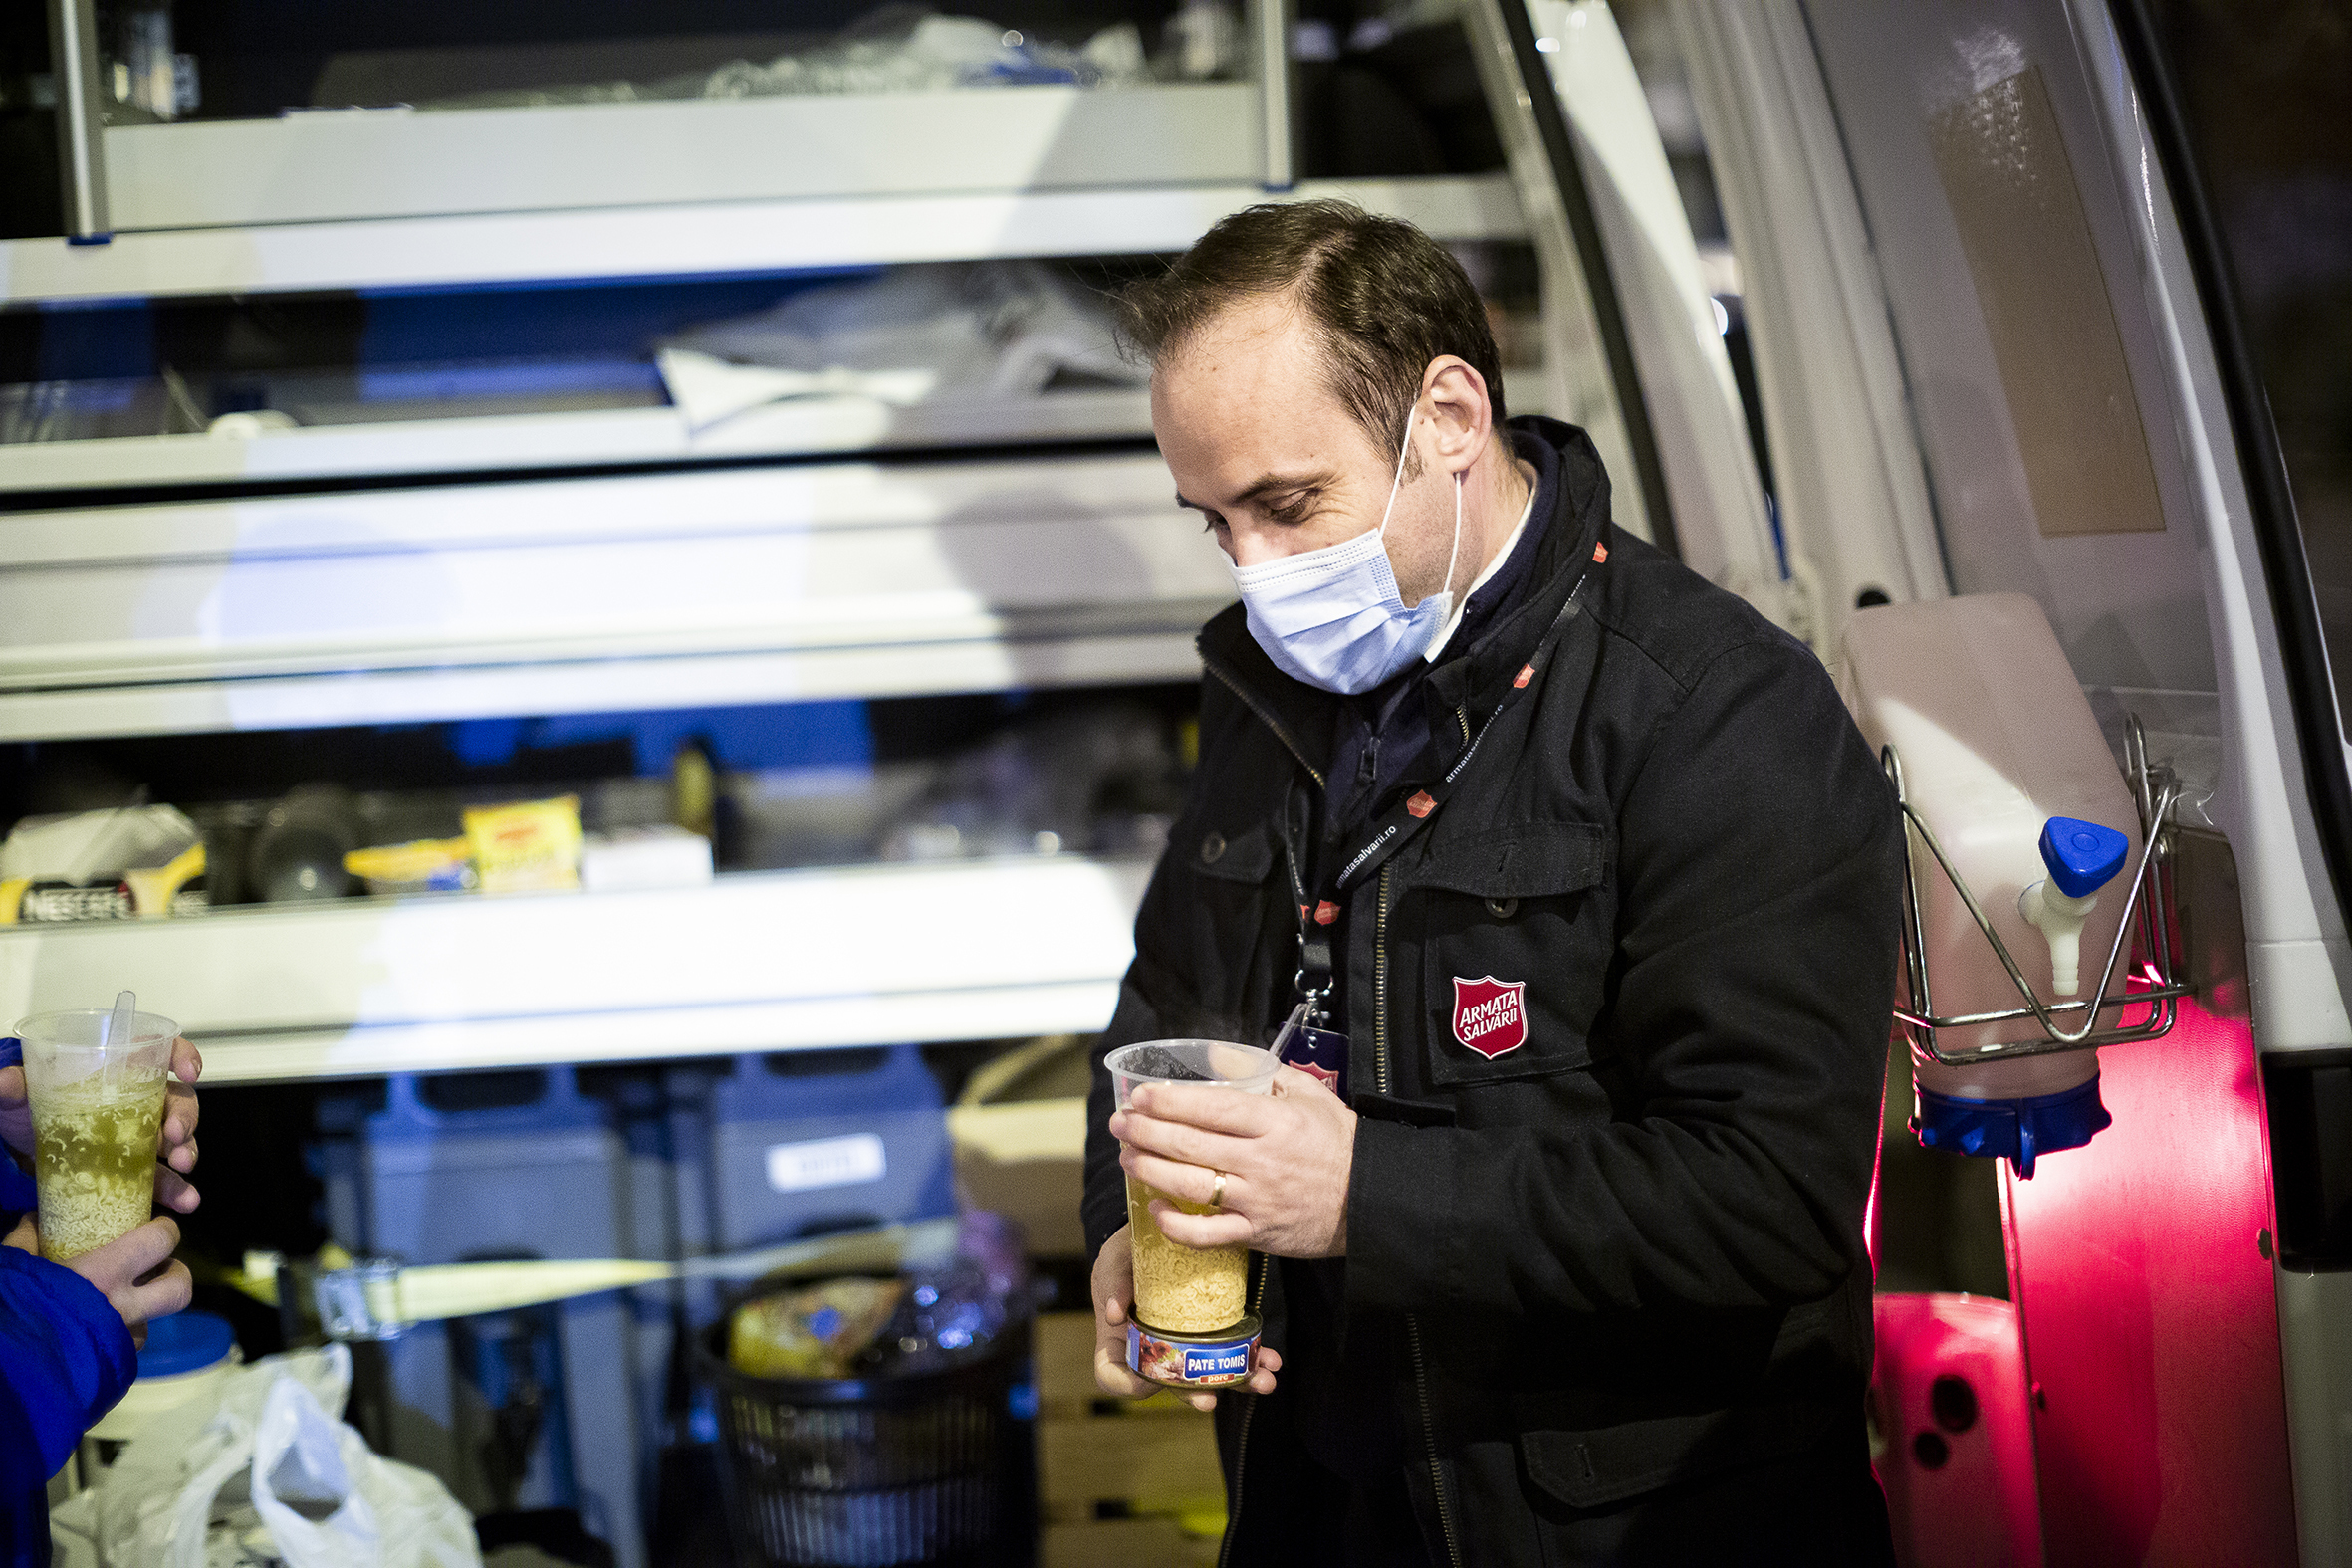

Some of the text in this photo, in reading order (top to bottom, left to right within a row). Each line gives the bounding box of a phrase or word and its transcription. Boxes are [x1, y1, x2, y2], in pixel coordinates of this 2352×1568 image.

[1459, 989, 1518, 1028] ARMATA
[1463, 1007, 1518, 1041] SALVĂRII
[1188, 1354, 1246, 1371] PATE TOMIS
[1207, 1374, 1229, 1383] porc
